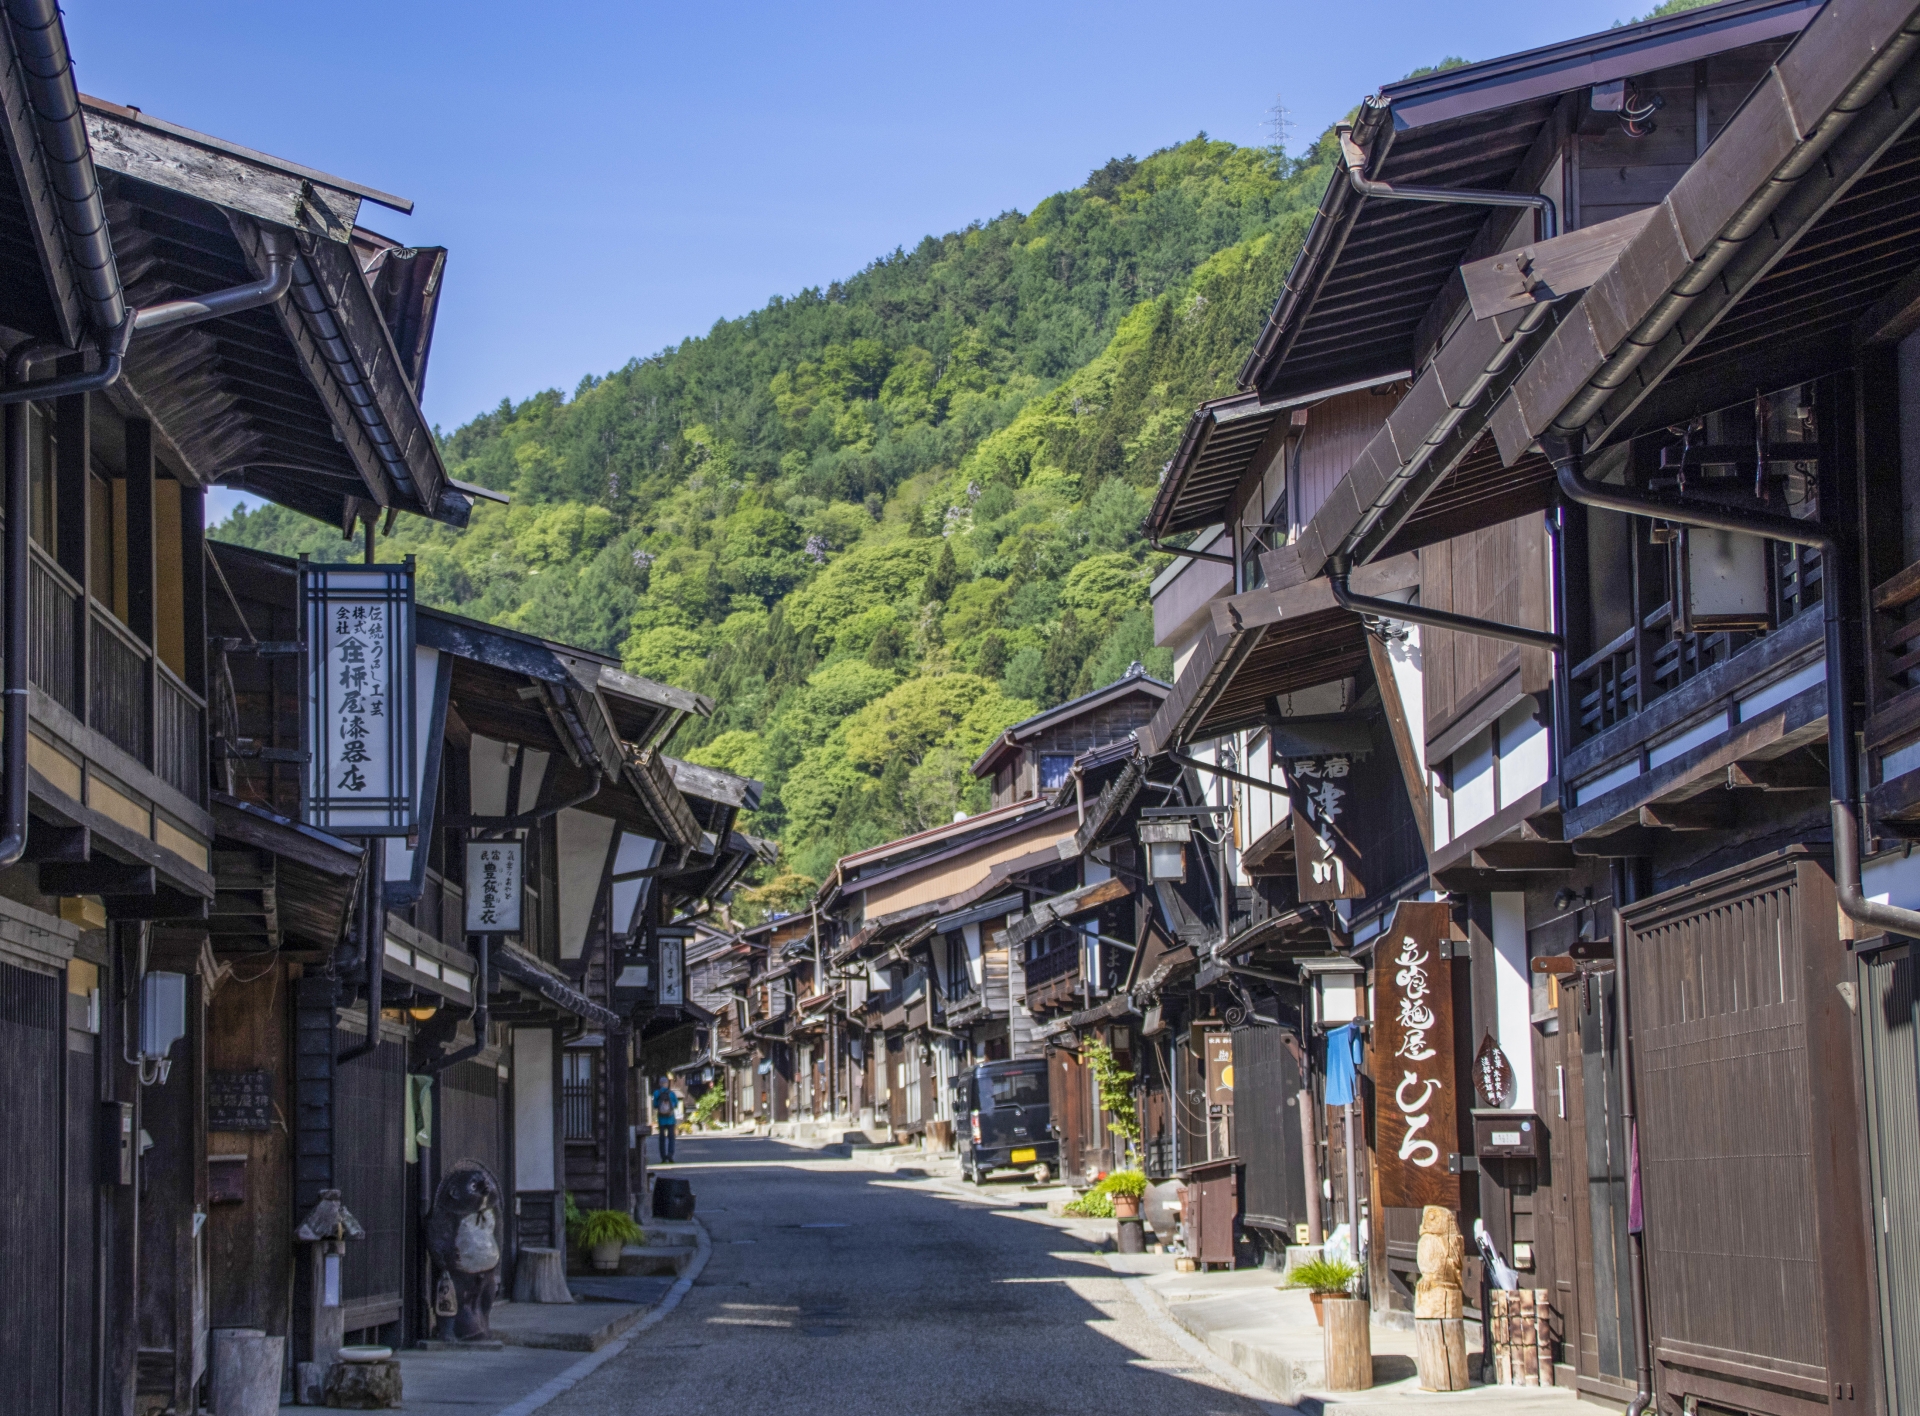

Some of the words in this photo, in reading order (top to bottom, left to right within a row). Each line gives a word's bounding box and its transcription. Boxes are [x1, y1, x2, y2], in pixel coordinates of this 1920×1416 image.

[368, 606, 385, 717] 伝統うるし工芸
[1294, 758, 1350, 778] 民宿
[480, 849, 501, 861] 民宿
